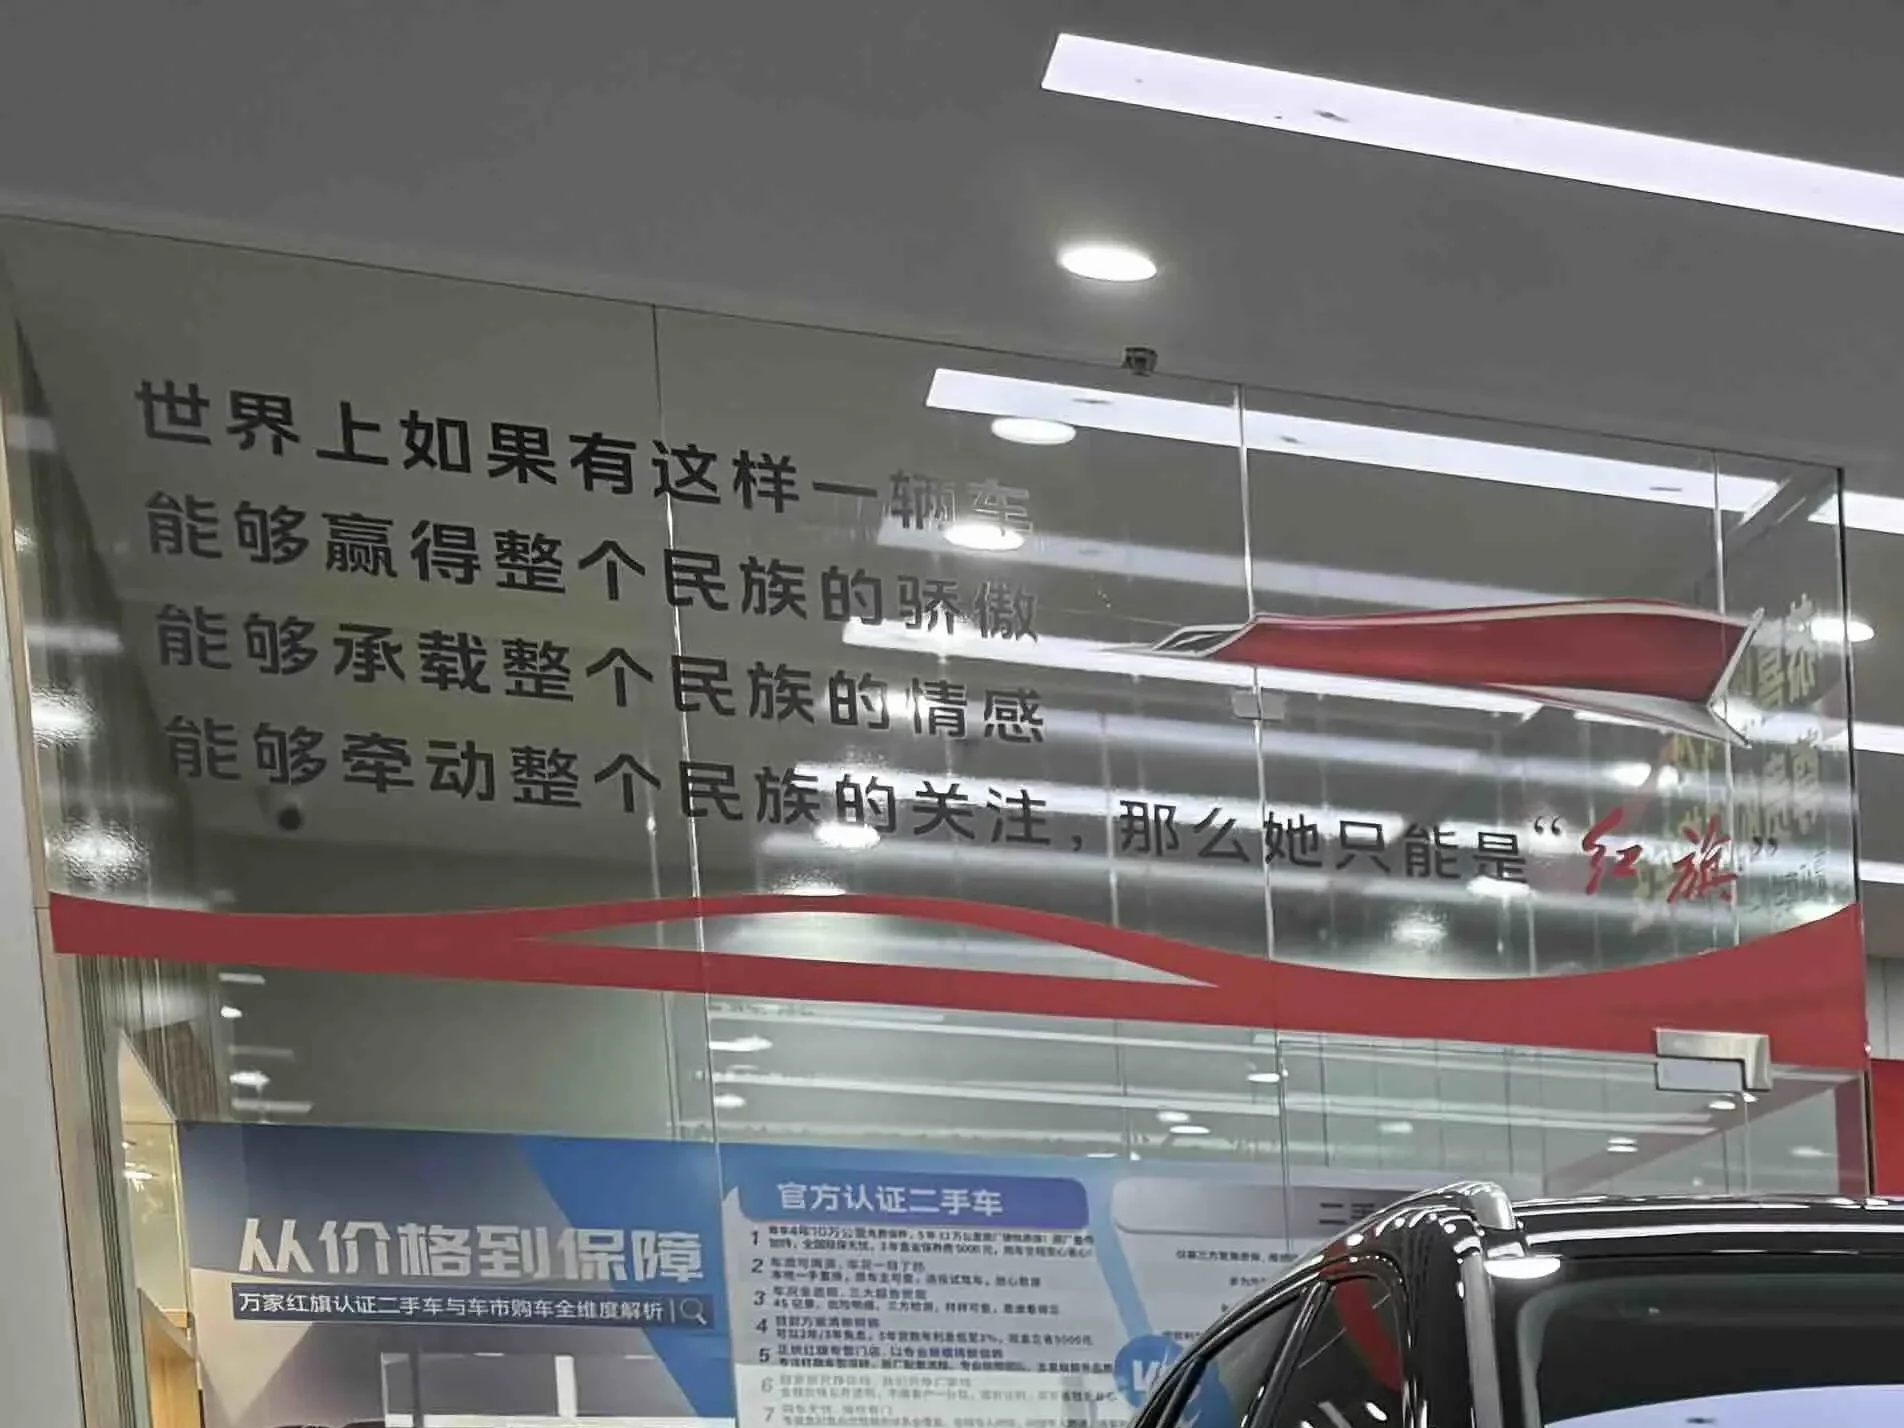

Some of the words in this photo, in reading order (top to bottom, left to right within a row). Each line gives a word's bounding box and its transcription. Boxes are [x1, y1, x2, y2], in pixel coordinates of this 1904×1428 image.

[136, 379, 1032, 537] 世界上如果有这样一辆车
[146, 490, 1038, 642] 能够赢得整个民族的骄傲
[157, 603, 1046, 746] 能够承载整个民族的情感
[239, 1216, 706, 1285] 从价格到保障
[776, 1180, 1004, 1219] 官方认证二手车
